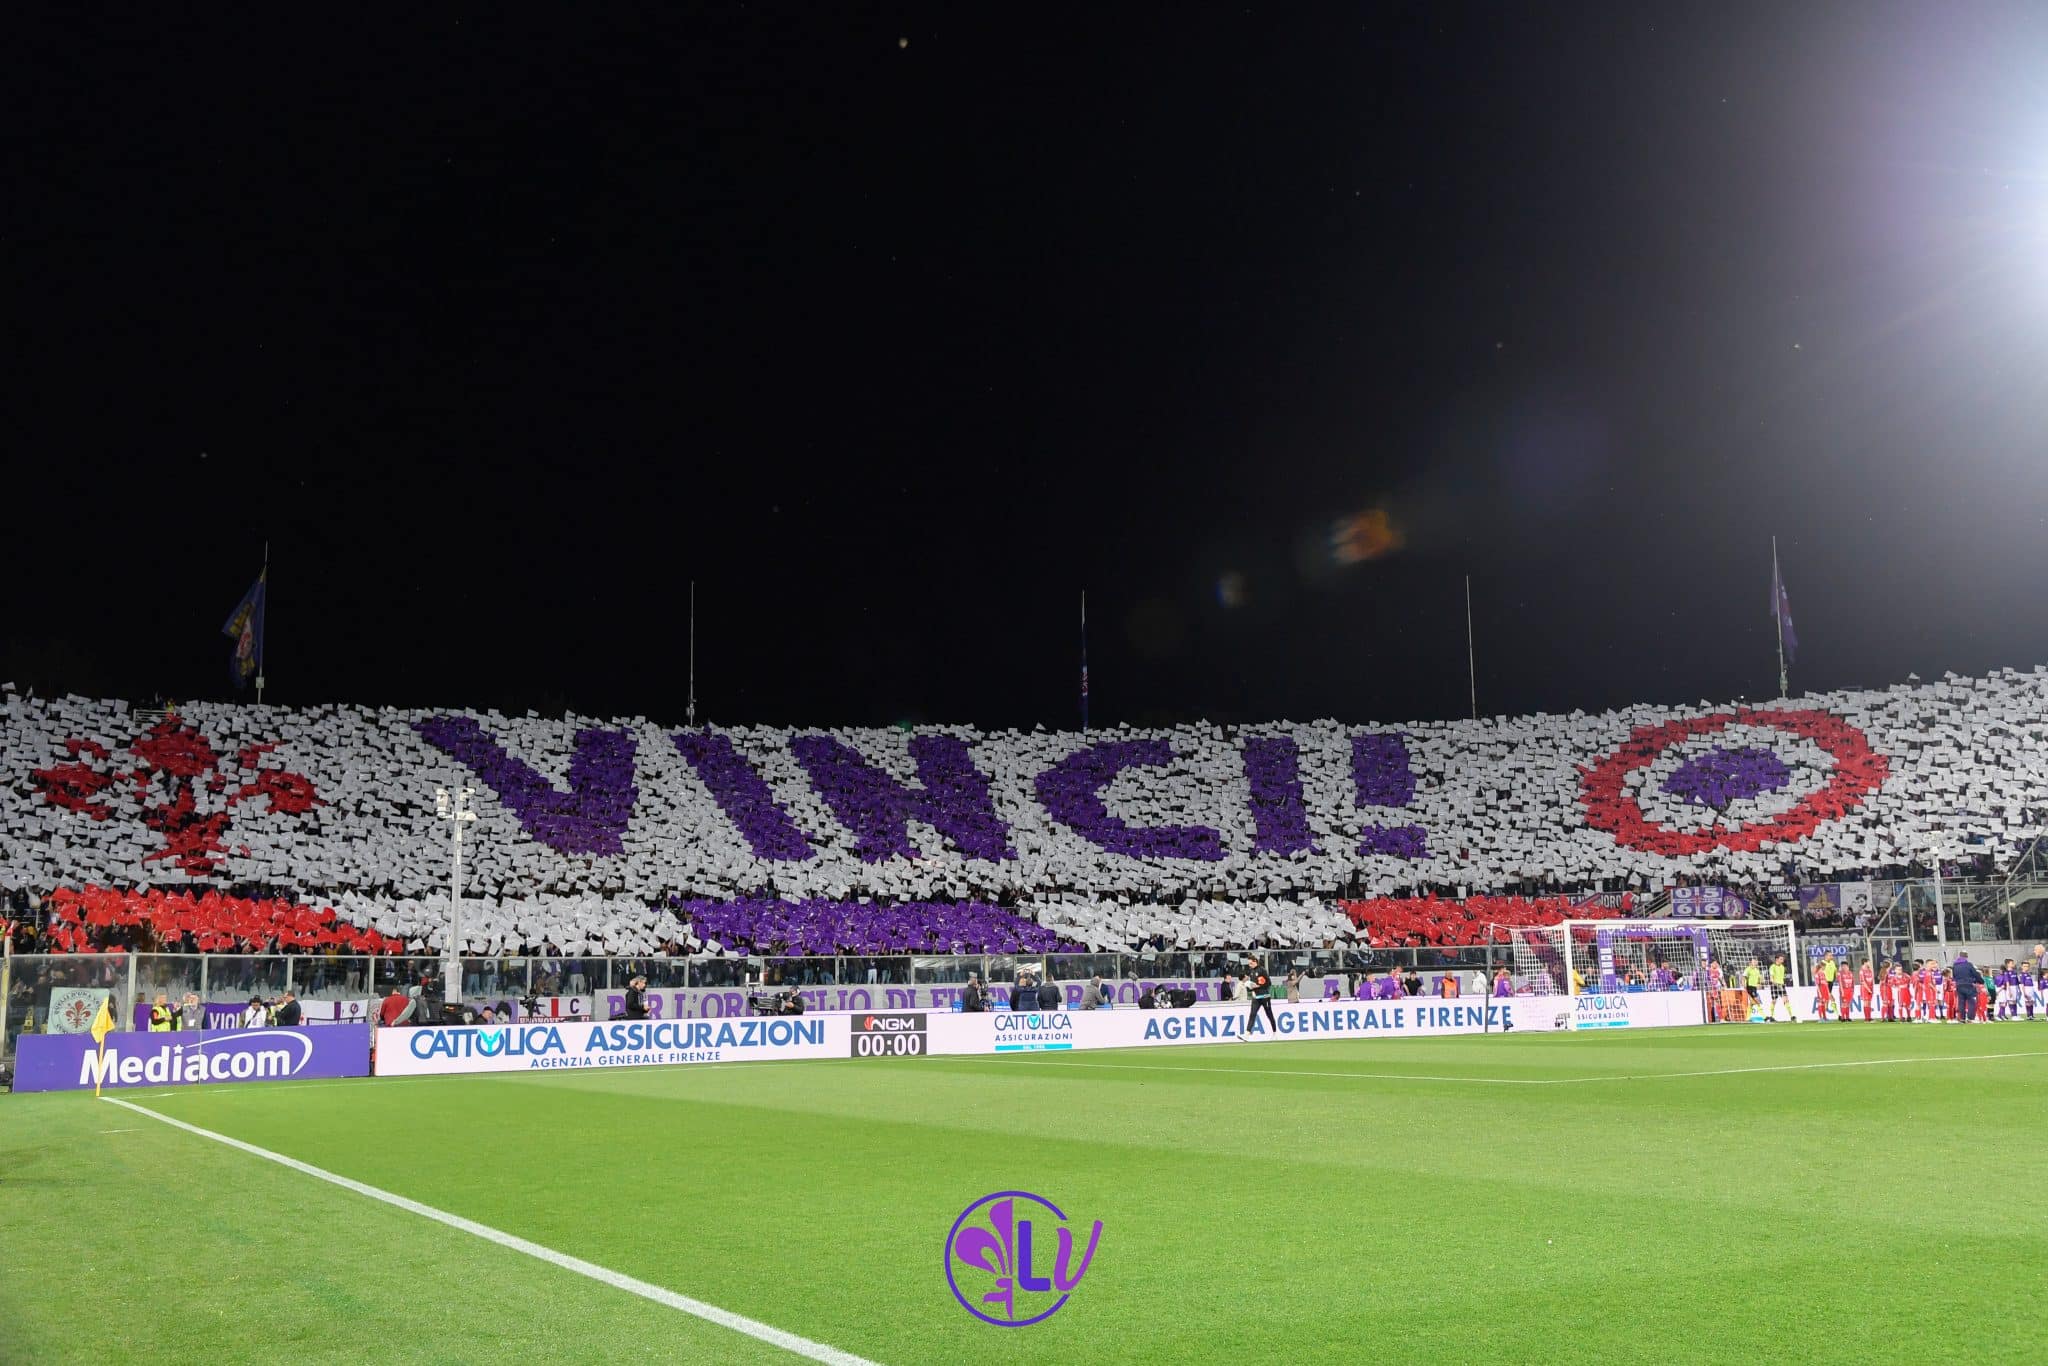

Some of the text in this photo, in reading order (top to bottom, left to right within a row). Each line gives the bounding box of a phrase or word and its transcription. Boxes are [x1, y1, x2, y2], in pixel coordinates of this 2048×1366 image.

[1575, 996, 1628, 1011] ATTOLICA
[874, 1017, 915, 1031] NGM
[994, 1013, 1072, 1031] CATTOLICA
[1277, 1008, 1404, 1034] GENERALE
[1416, 1005, 1511, 1028] FIRENZE
[410, 1020, 825, 1058] CATTOLICA ASSICURAZIONI
[858, 1034, 920, 1057] 00:00
[995, 1033, 1073, 1042] ASSICURAZIONI
[80, 1044, 290, 1086] Mediacom
[530, 1052, 721, 1070] AGENZIA GENERALE FIRENZE
